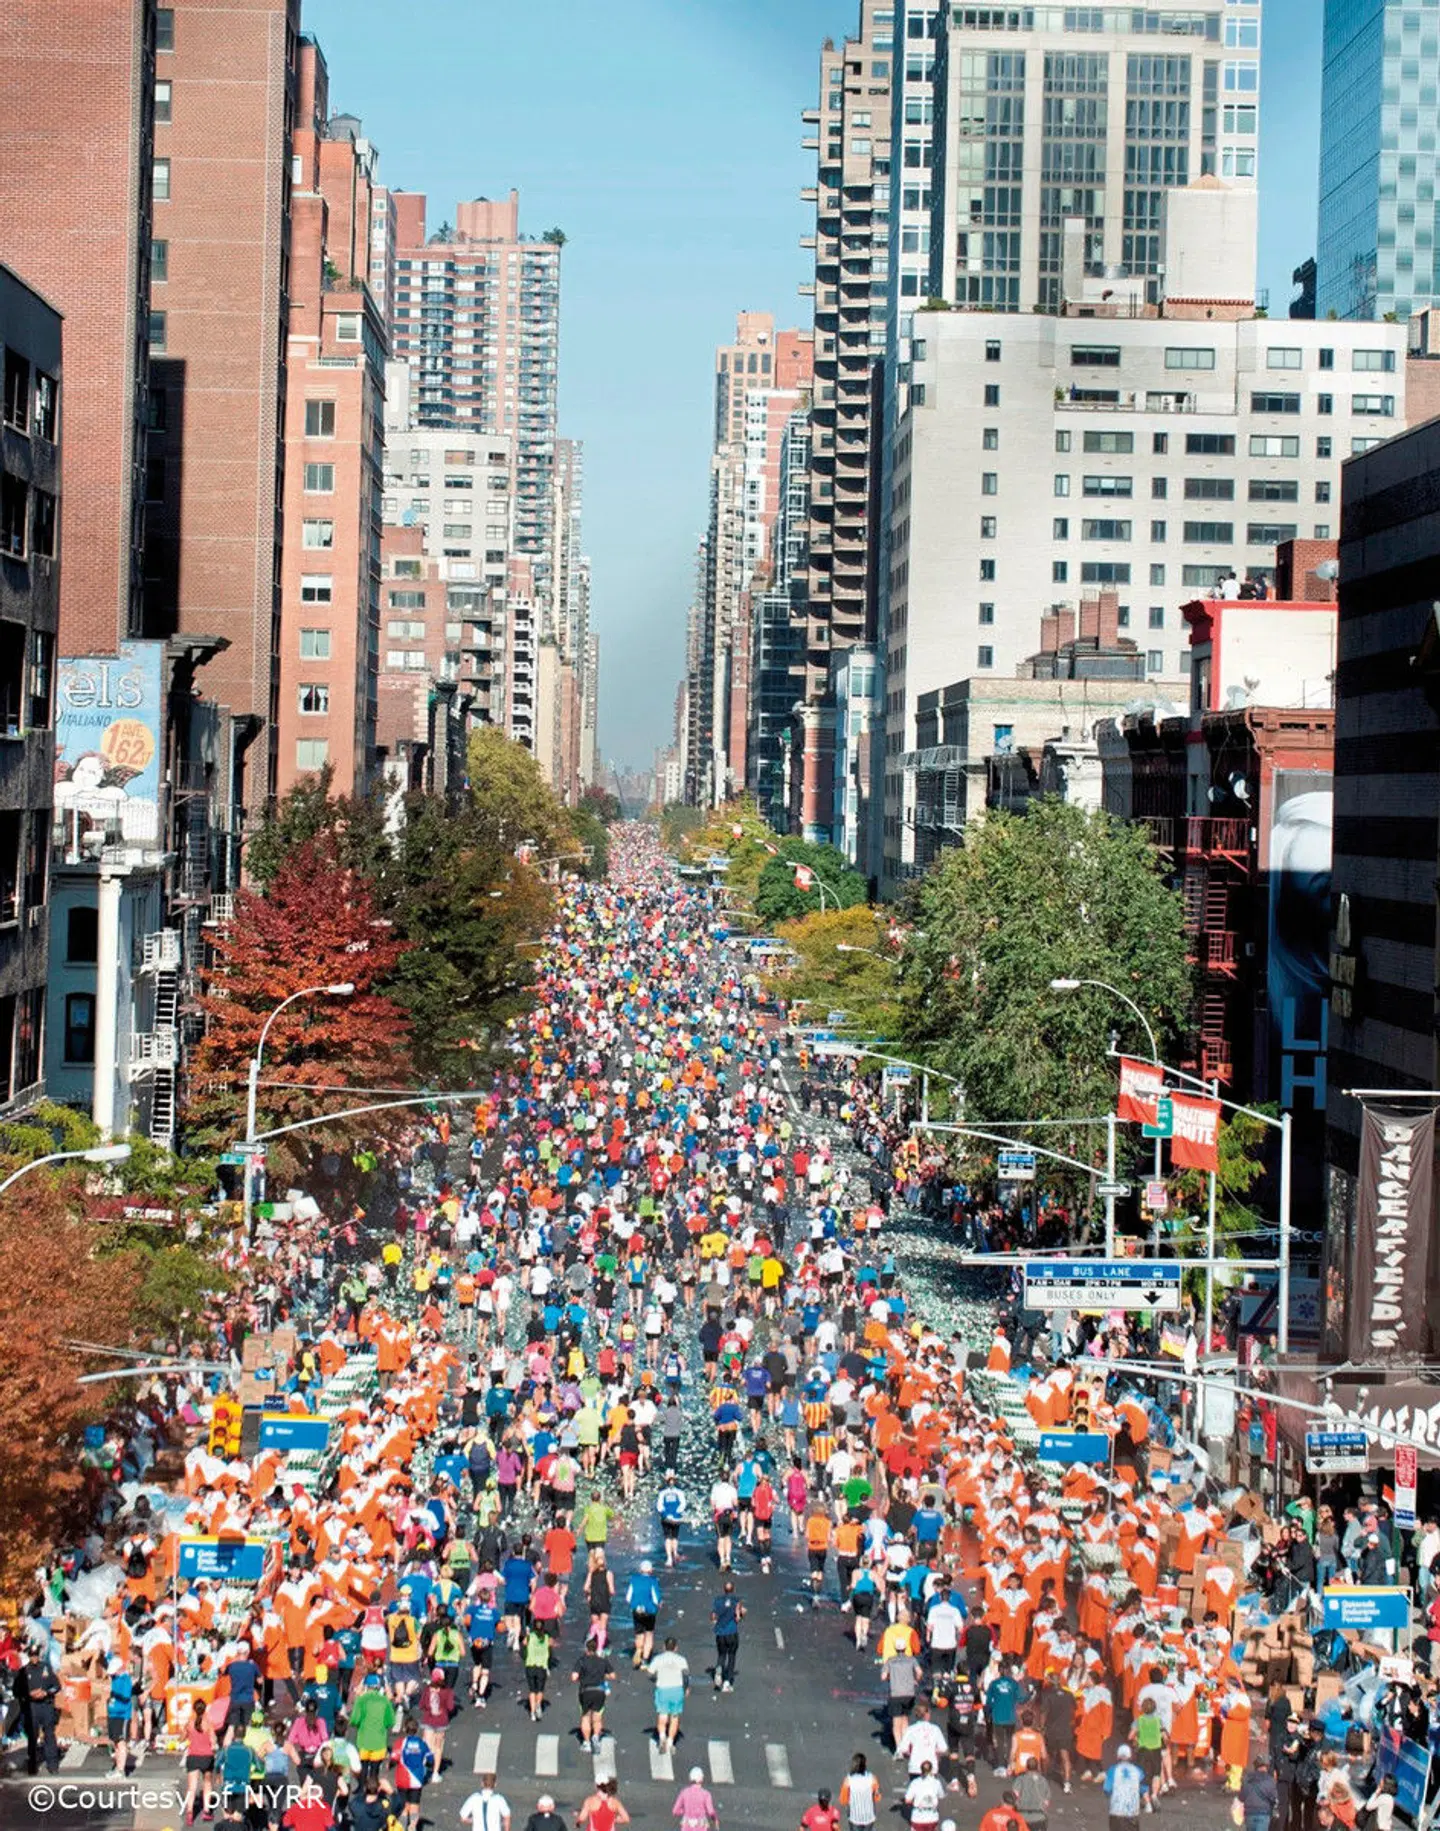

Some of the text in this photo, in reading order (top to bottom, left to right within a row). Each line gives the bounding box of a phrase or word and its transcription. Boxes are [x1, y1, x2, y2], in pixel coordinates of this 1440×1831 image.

[63, 661, 144, 708] els
[62, 713, 113, 728] ITALIANO
[115, 739, 146, 764] 62
[1370, 1123, 1414, 1349] DANGERFIELD'S
[1072, 1266, 1131, 1277] BUS LANE
[1046, 1290, 1117, 1300] BUSES ONLY
[1326, 1399, 1440, 1450] DANGERF
